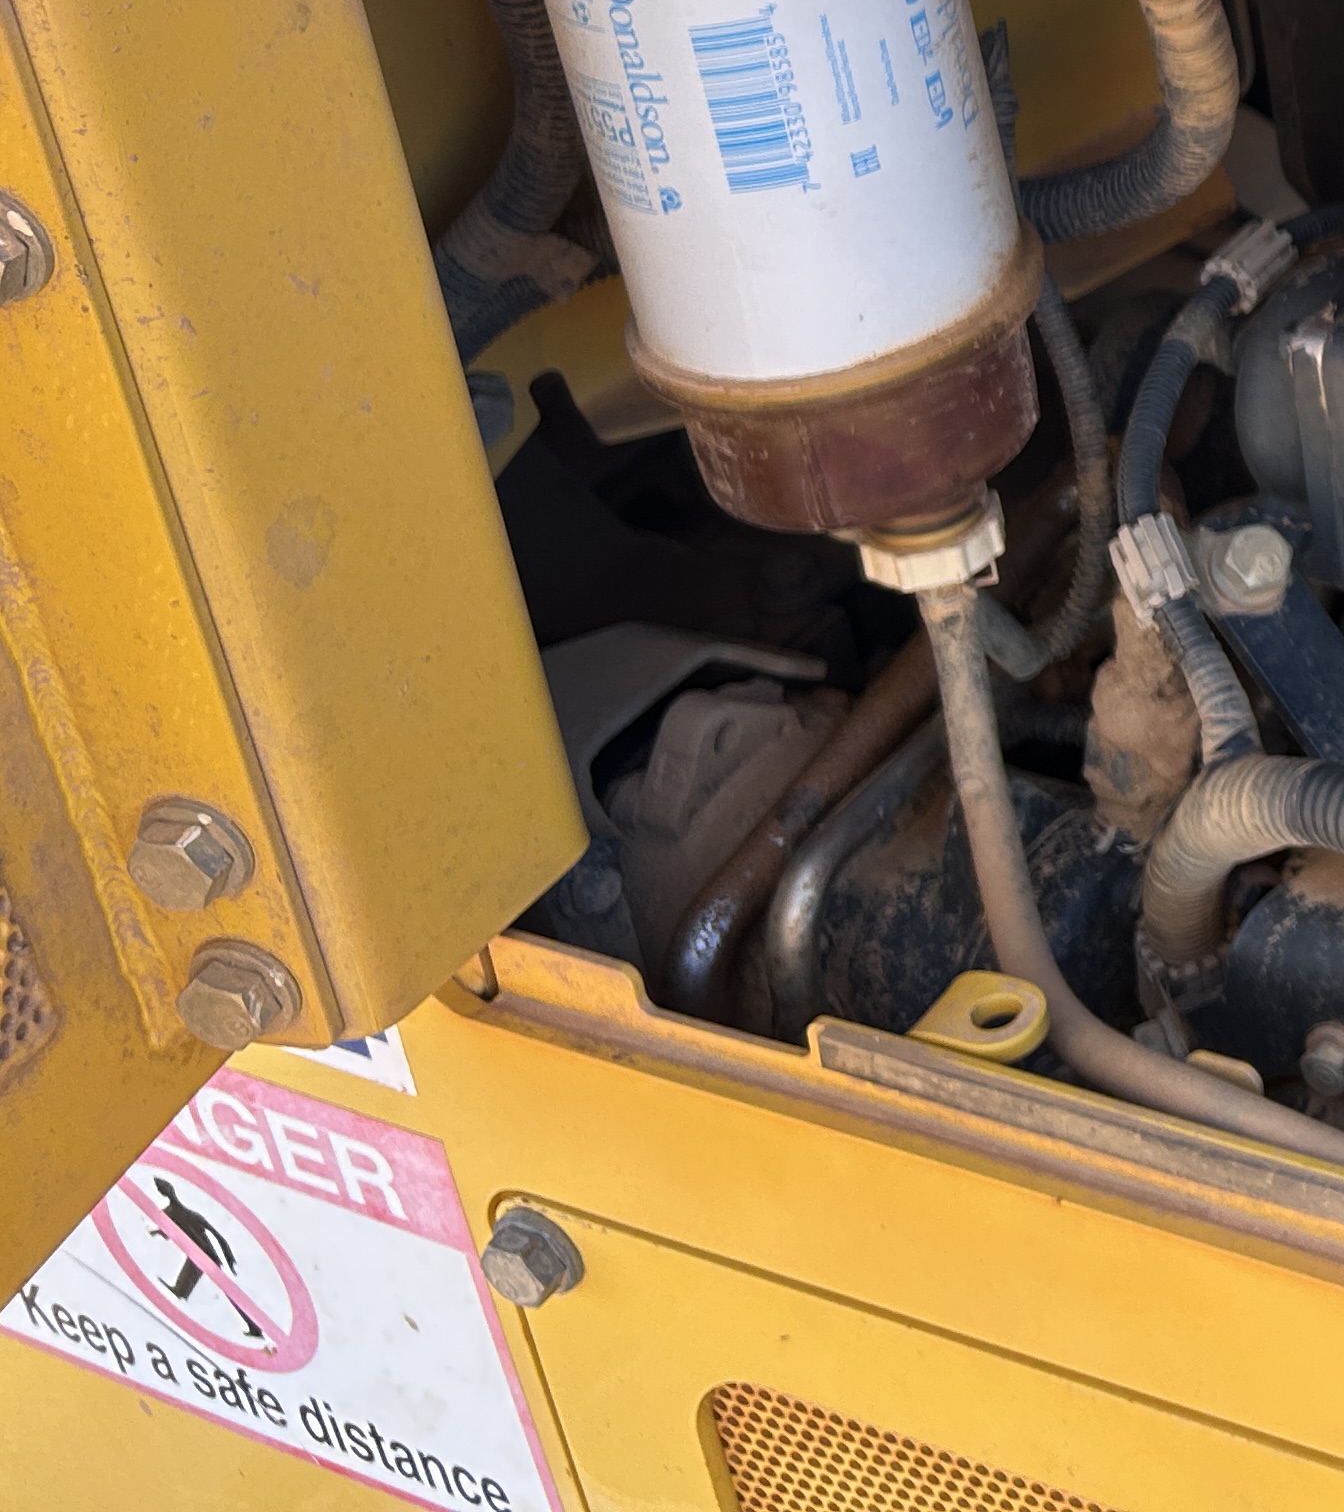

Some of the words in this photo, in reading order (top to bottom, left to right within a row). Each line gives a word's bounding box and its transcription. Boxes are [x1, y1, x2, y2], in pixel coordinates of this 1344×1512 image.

[766, 32, 798, 97] 98585
[783, 101, 814, 164] 42330
[19, 1284, 136, 1375] Keep
[146, 1341, 181, 1386] a
[186, 1358, 288, 1428] safe
[299, 1395, 513, 1512] distance
